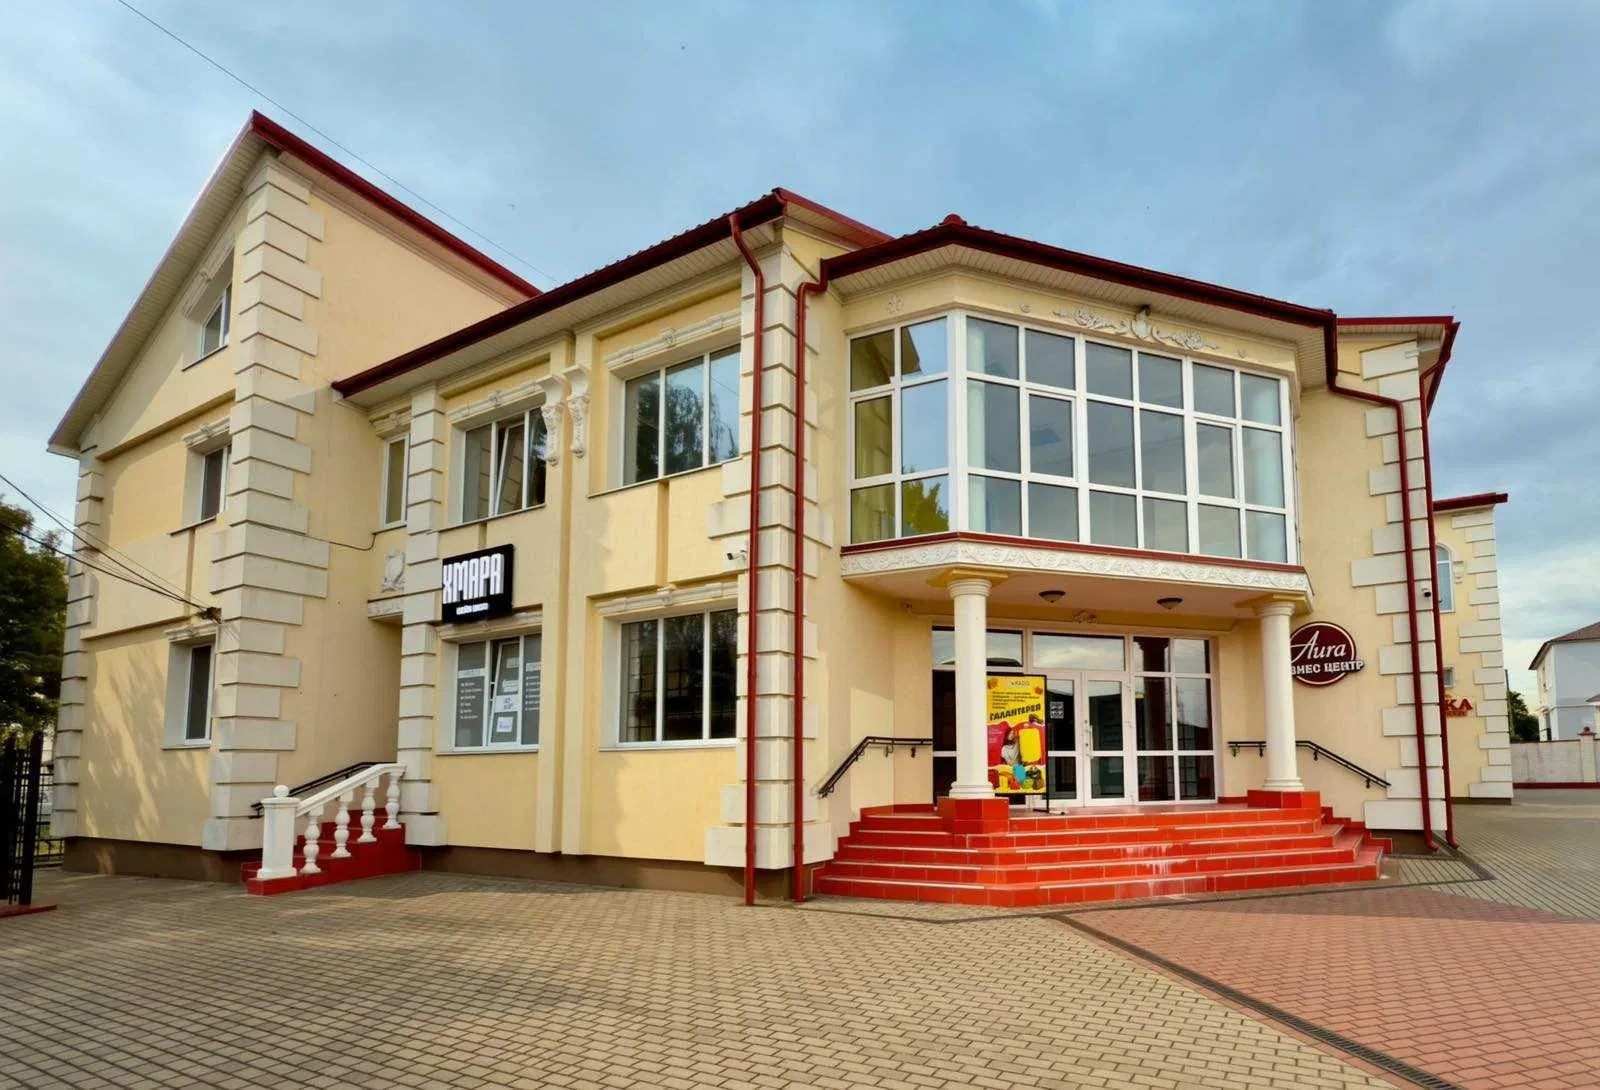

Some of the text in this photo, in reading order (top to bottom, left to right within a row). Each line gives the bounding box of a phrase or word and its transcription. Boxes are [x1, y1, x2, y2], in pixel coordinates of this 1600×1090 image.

[443, 553, 504, 604] ХМАРА
[1290, 630, 1346, 662] Aura
[1324, 660, 1364, 673] ЦЕНТР
[990, 703, 1041, 722] ГАЛАНТЕРЕЯ
